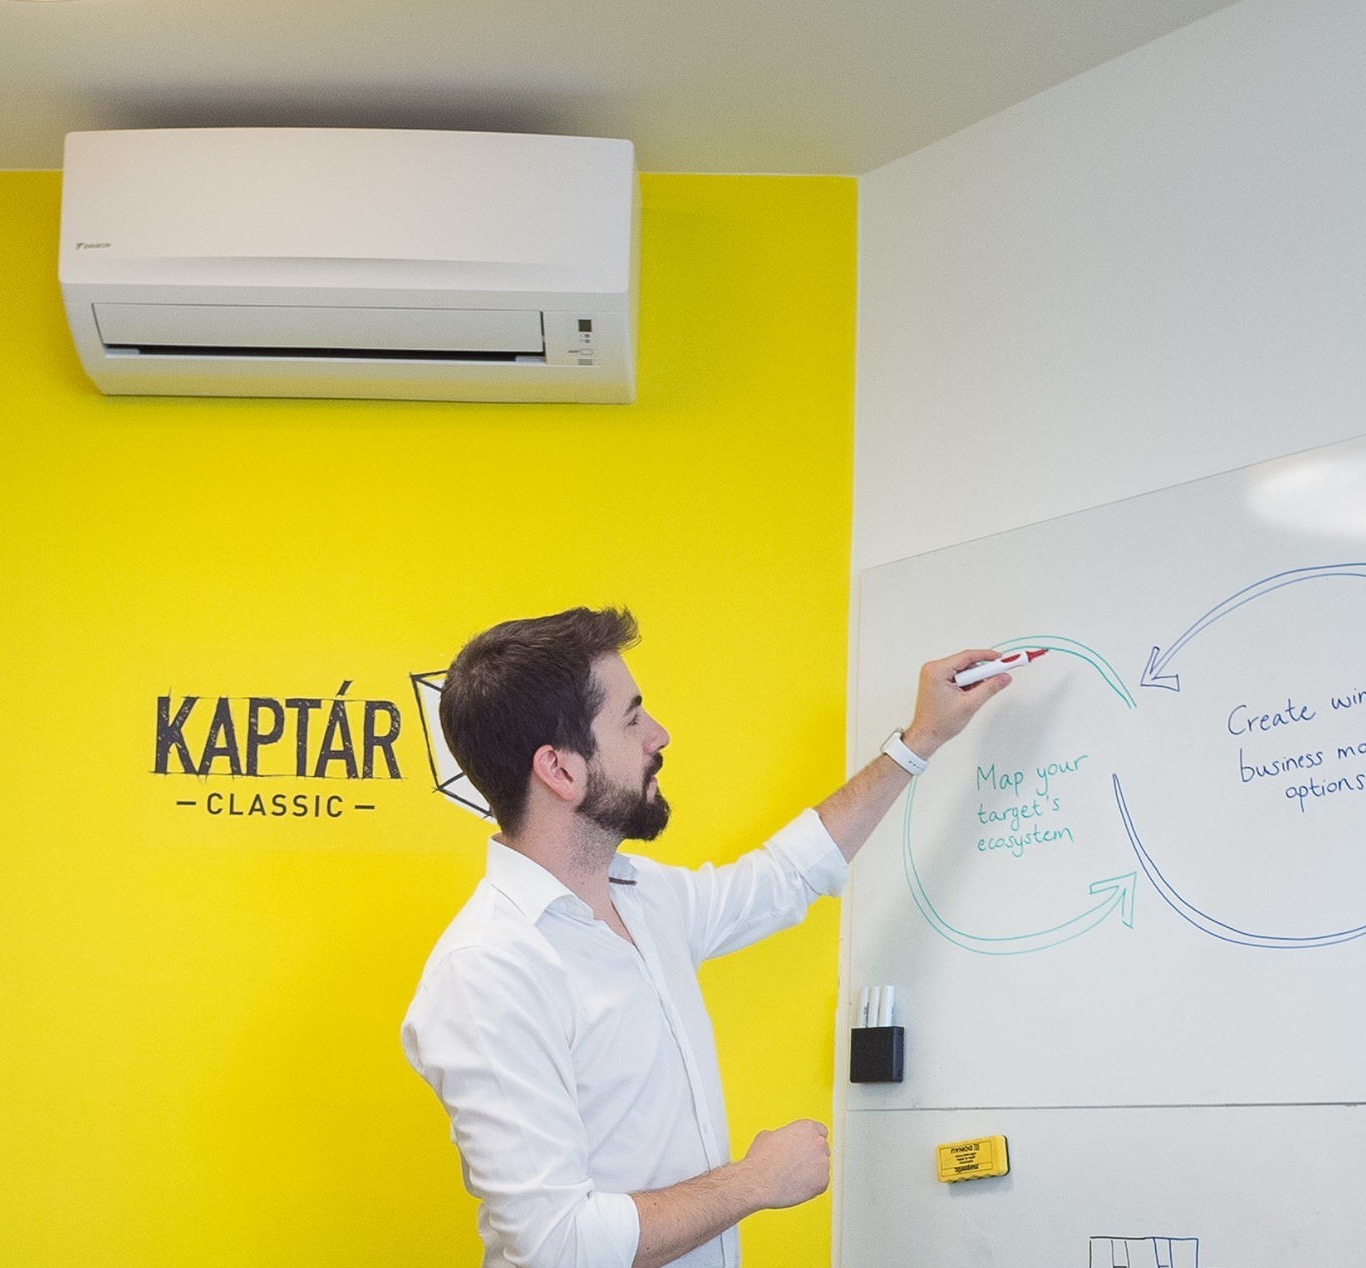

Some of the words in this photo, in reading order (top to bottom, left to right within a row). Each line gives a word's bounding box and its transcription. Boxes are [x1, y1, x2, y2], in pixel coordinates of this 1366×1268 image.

[152, 680, 404, 780] KAPTÁR
[1227, 698, 1316, 736] Create
[976, 763, 1024, 797] Map
[1035, 754, 1089, 797] your
[1239, 748, 1324, 783] business
[206, 792, 343, 818] CLASSIC
[1285, 773, 1366, 813] options
[977, 795, 1060, 832] target's
[977, 823, 1075, 858] ecosystem
